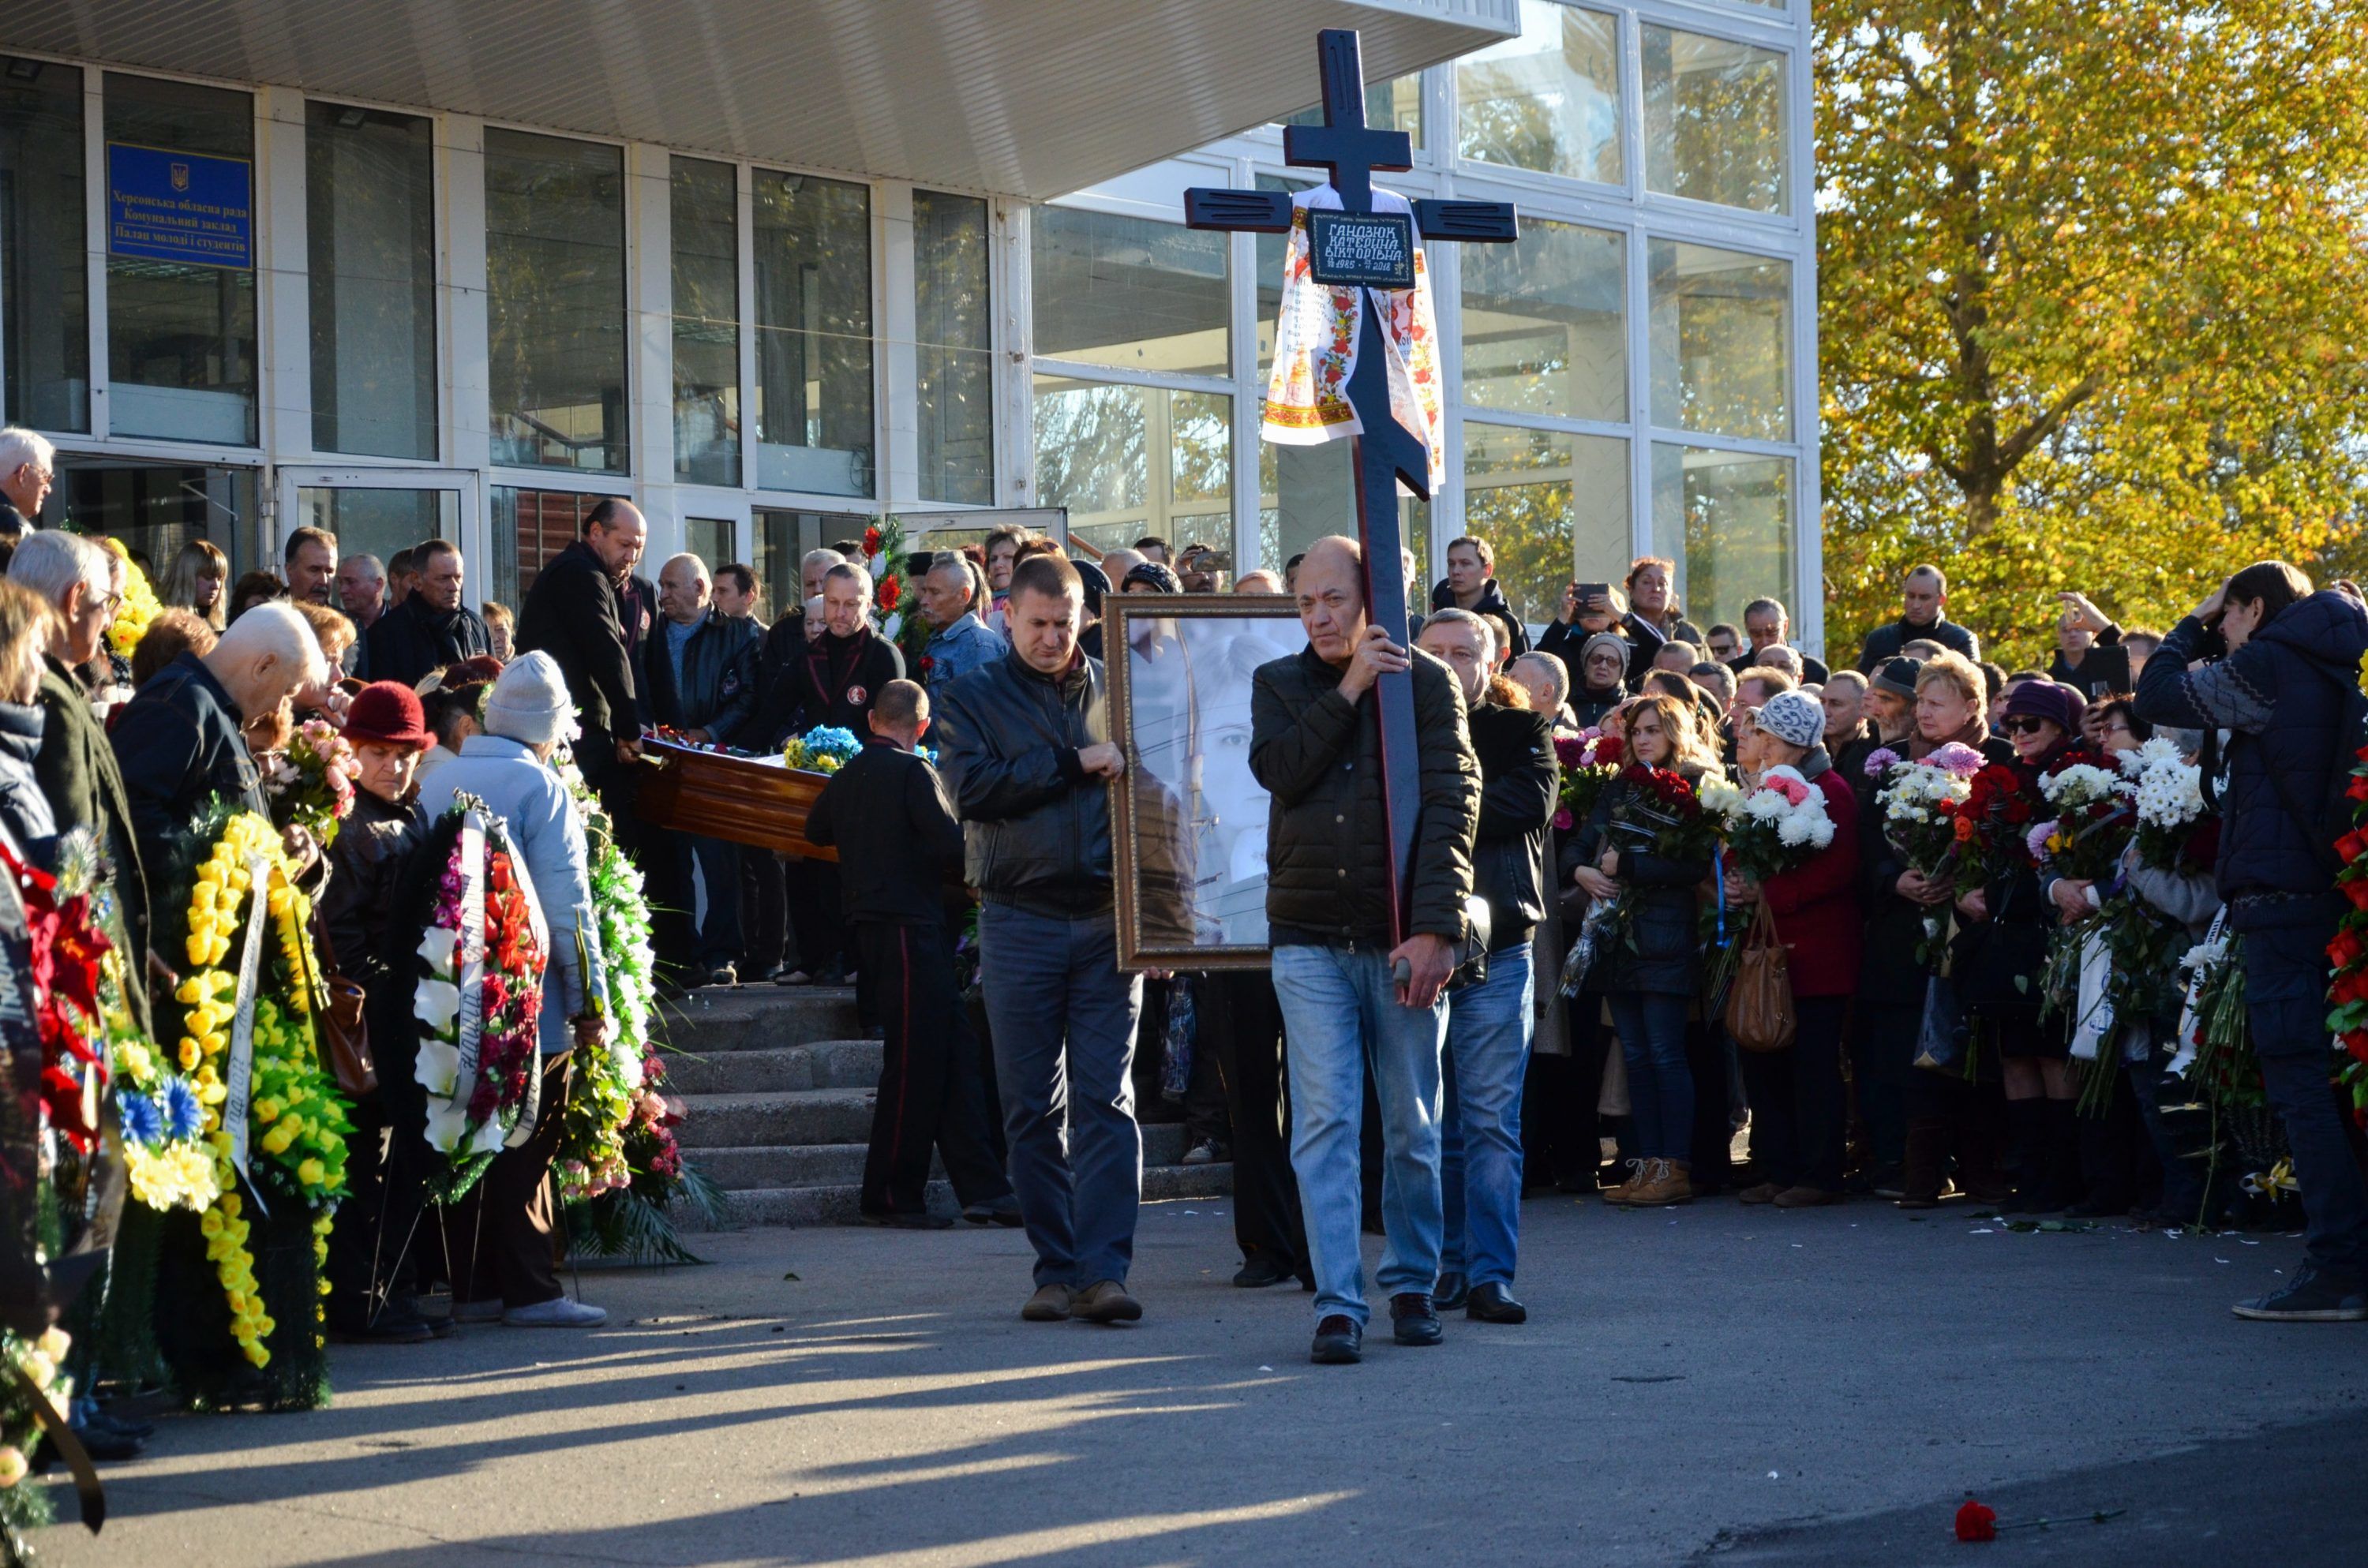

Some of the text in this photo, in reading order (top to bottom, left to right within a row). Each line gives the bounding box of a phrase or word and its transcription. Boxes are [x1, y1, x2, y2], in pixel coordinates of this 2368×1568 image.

[113, 189, 247, 219] Херсонська обласна рада
[125, 208, 237, 233] Комунальний заклад
[115, 226, 149, 240] Палац
[153, 233, 189, 245] молоді
[197, 236, 245, 252] студентів
[1328, 224, 1396, 239] ГАНДЗЮК
[1329, 236, 1399, 249] КАТЕРИНА
[1325, 246, 1403, 260] ВІКТОРІВНА
[1336, 260, 1355, 269] 1985
[1373, 261, 1391, 271] 2018
